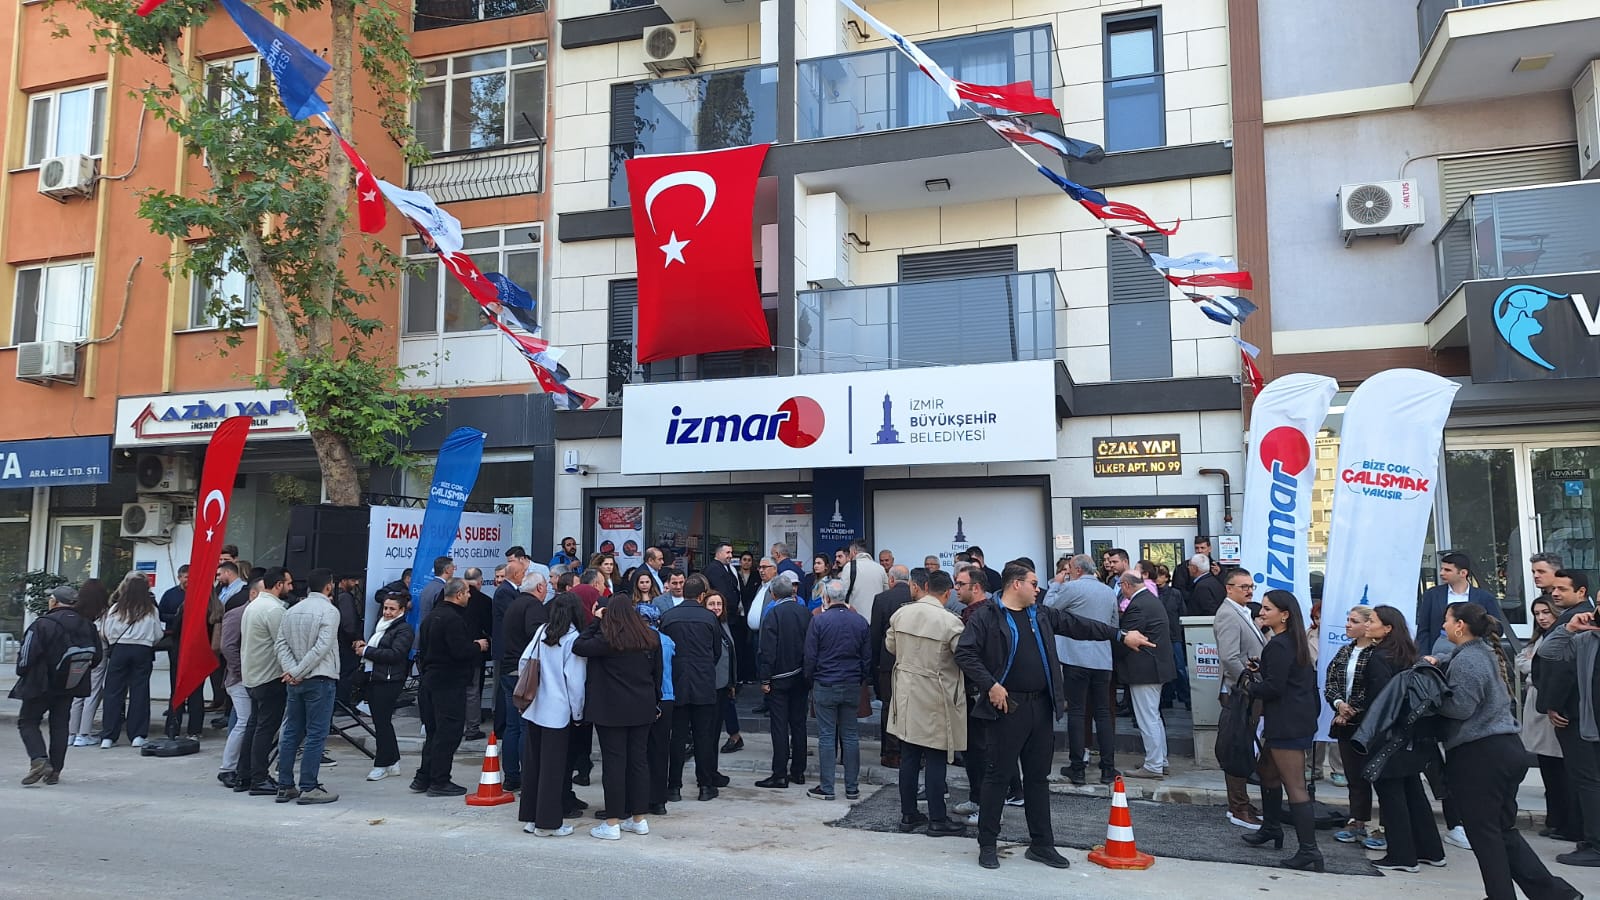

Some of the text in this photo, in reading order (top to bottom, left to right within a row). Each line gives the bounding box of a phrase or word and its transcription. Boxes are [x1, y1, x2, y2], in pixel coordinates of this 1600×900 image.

[1402, 182, 1410, 203] ALTUS
[160, 400, 298, 422] AZİM YAPI
[909, 397, 944, 411] İZMİR
[665, 405, 790, 445] izmar
[909, 410, 997, 428] BÜYÜKŞEHİR
[909, 427, 986, 444] BELEDİYESİ
[1142, 440, 1176, 454] YAPI
[29, 469, 49, 478] ARA.
[68, 468, 85, 476] LTD.
[1095, 461, 1181, 474] ÜLKER APT. NO 99
[1362, 459, 1411, 475] BİZE ÇOK
[1341, 469, 1430, 493] ÇALIŞMAK
[1363, 487, 1403, 501] YAKIŞIR
[464, 524, 501, 543] ŞUBESİ
[1254, 461, 1298, 592] izmar
[385, 546, 413, 559] AÇILIŞ
[453, 547, 470, 559] HOŞ
[470, 545, 500, 558] GELDİNİZ
